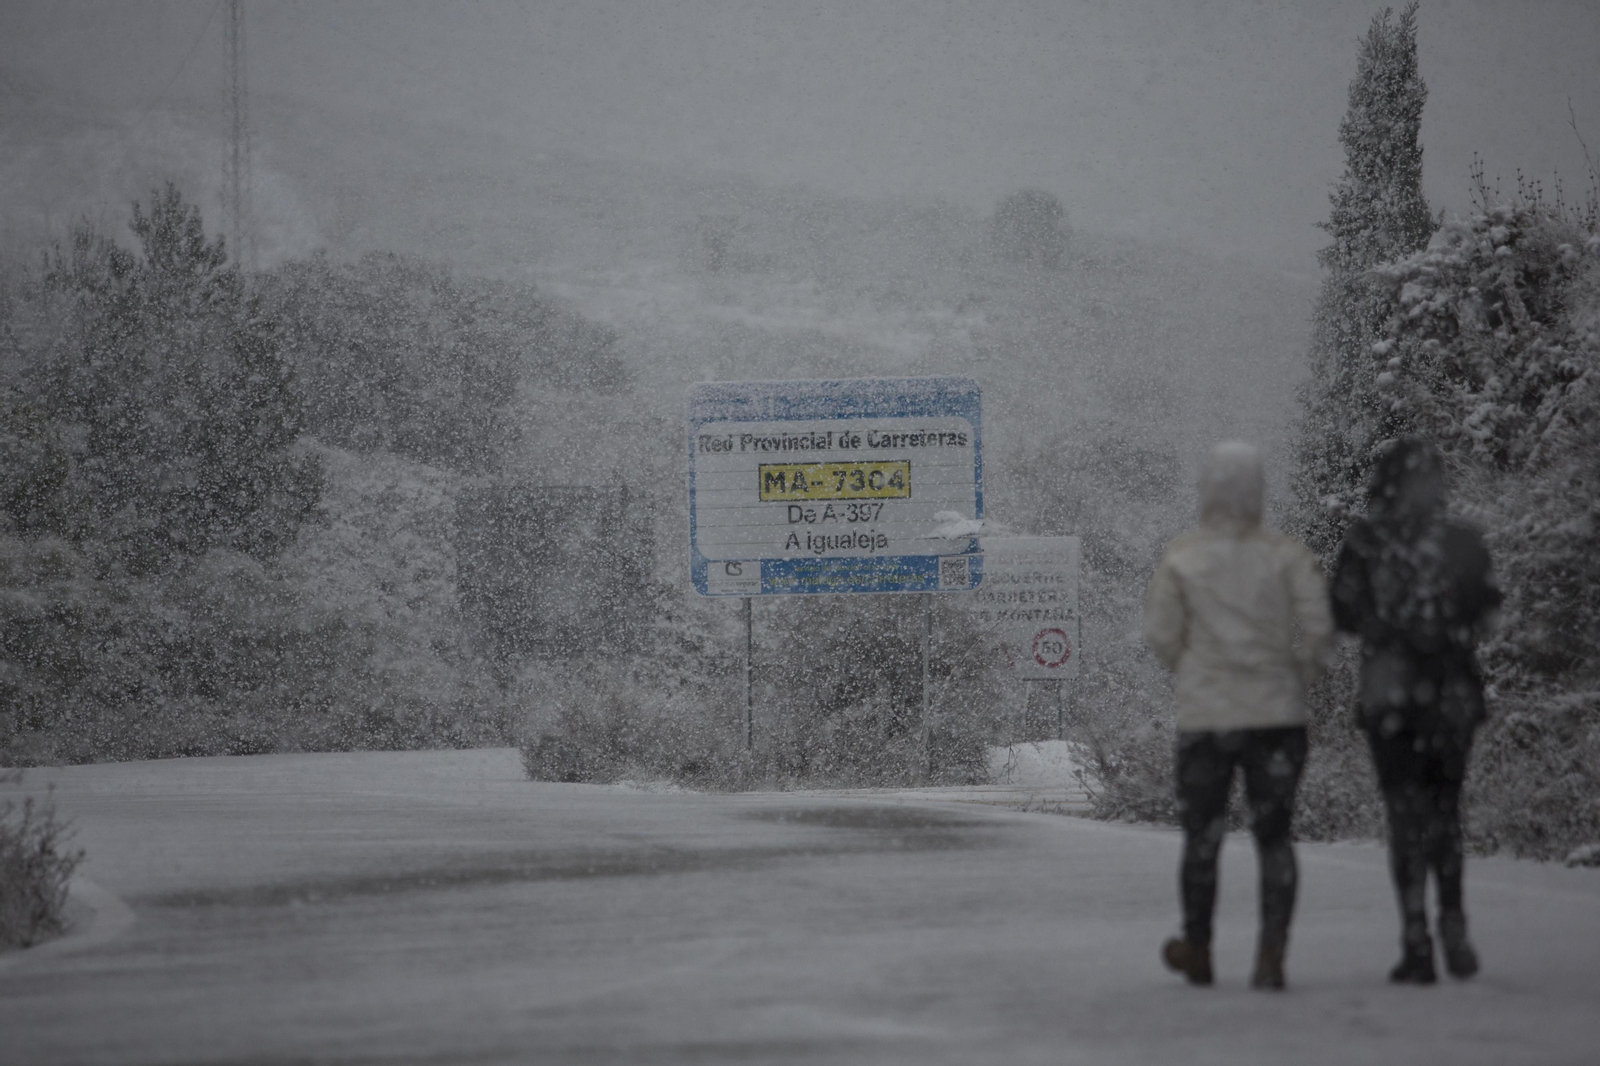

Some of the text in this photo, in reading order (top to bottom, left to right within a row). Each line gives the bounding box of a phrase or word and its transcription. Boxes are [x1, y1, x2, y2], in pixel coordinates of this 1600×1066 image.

[699, 429, 968, 453] Red Provincial de Carreteras
[787, 503, 885, 524] De A-397
[785, 530, 802, 550] A
